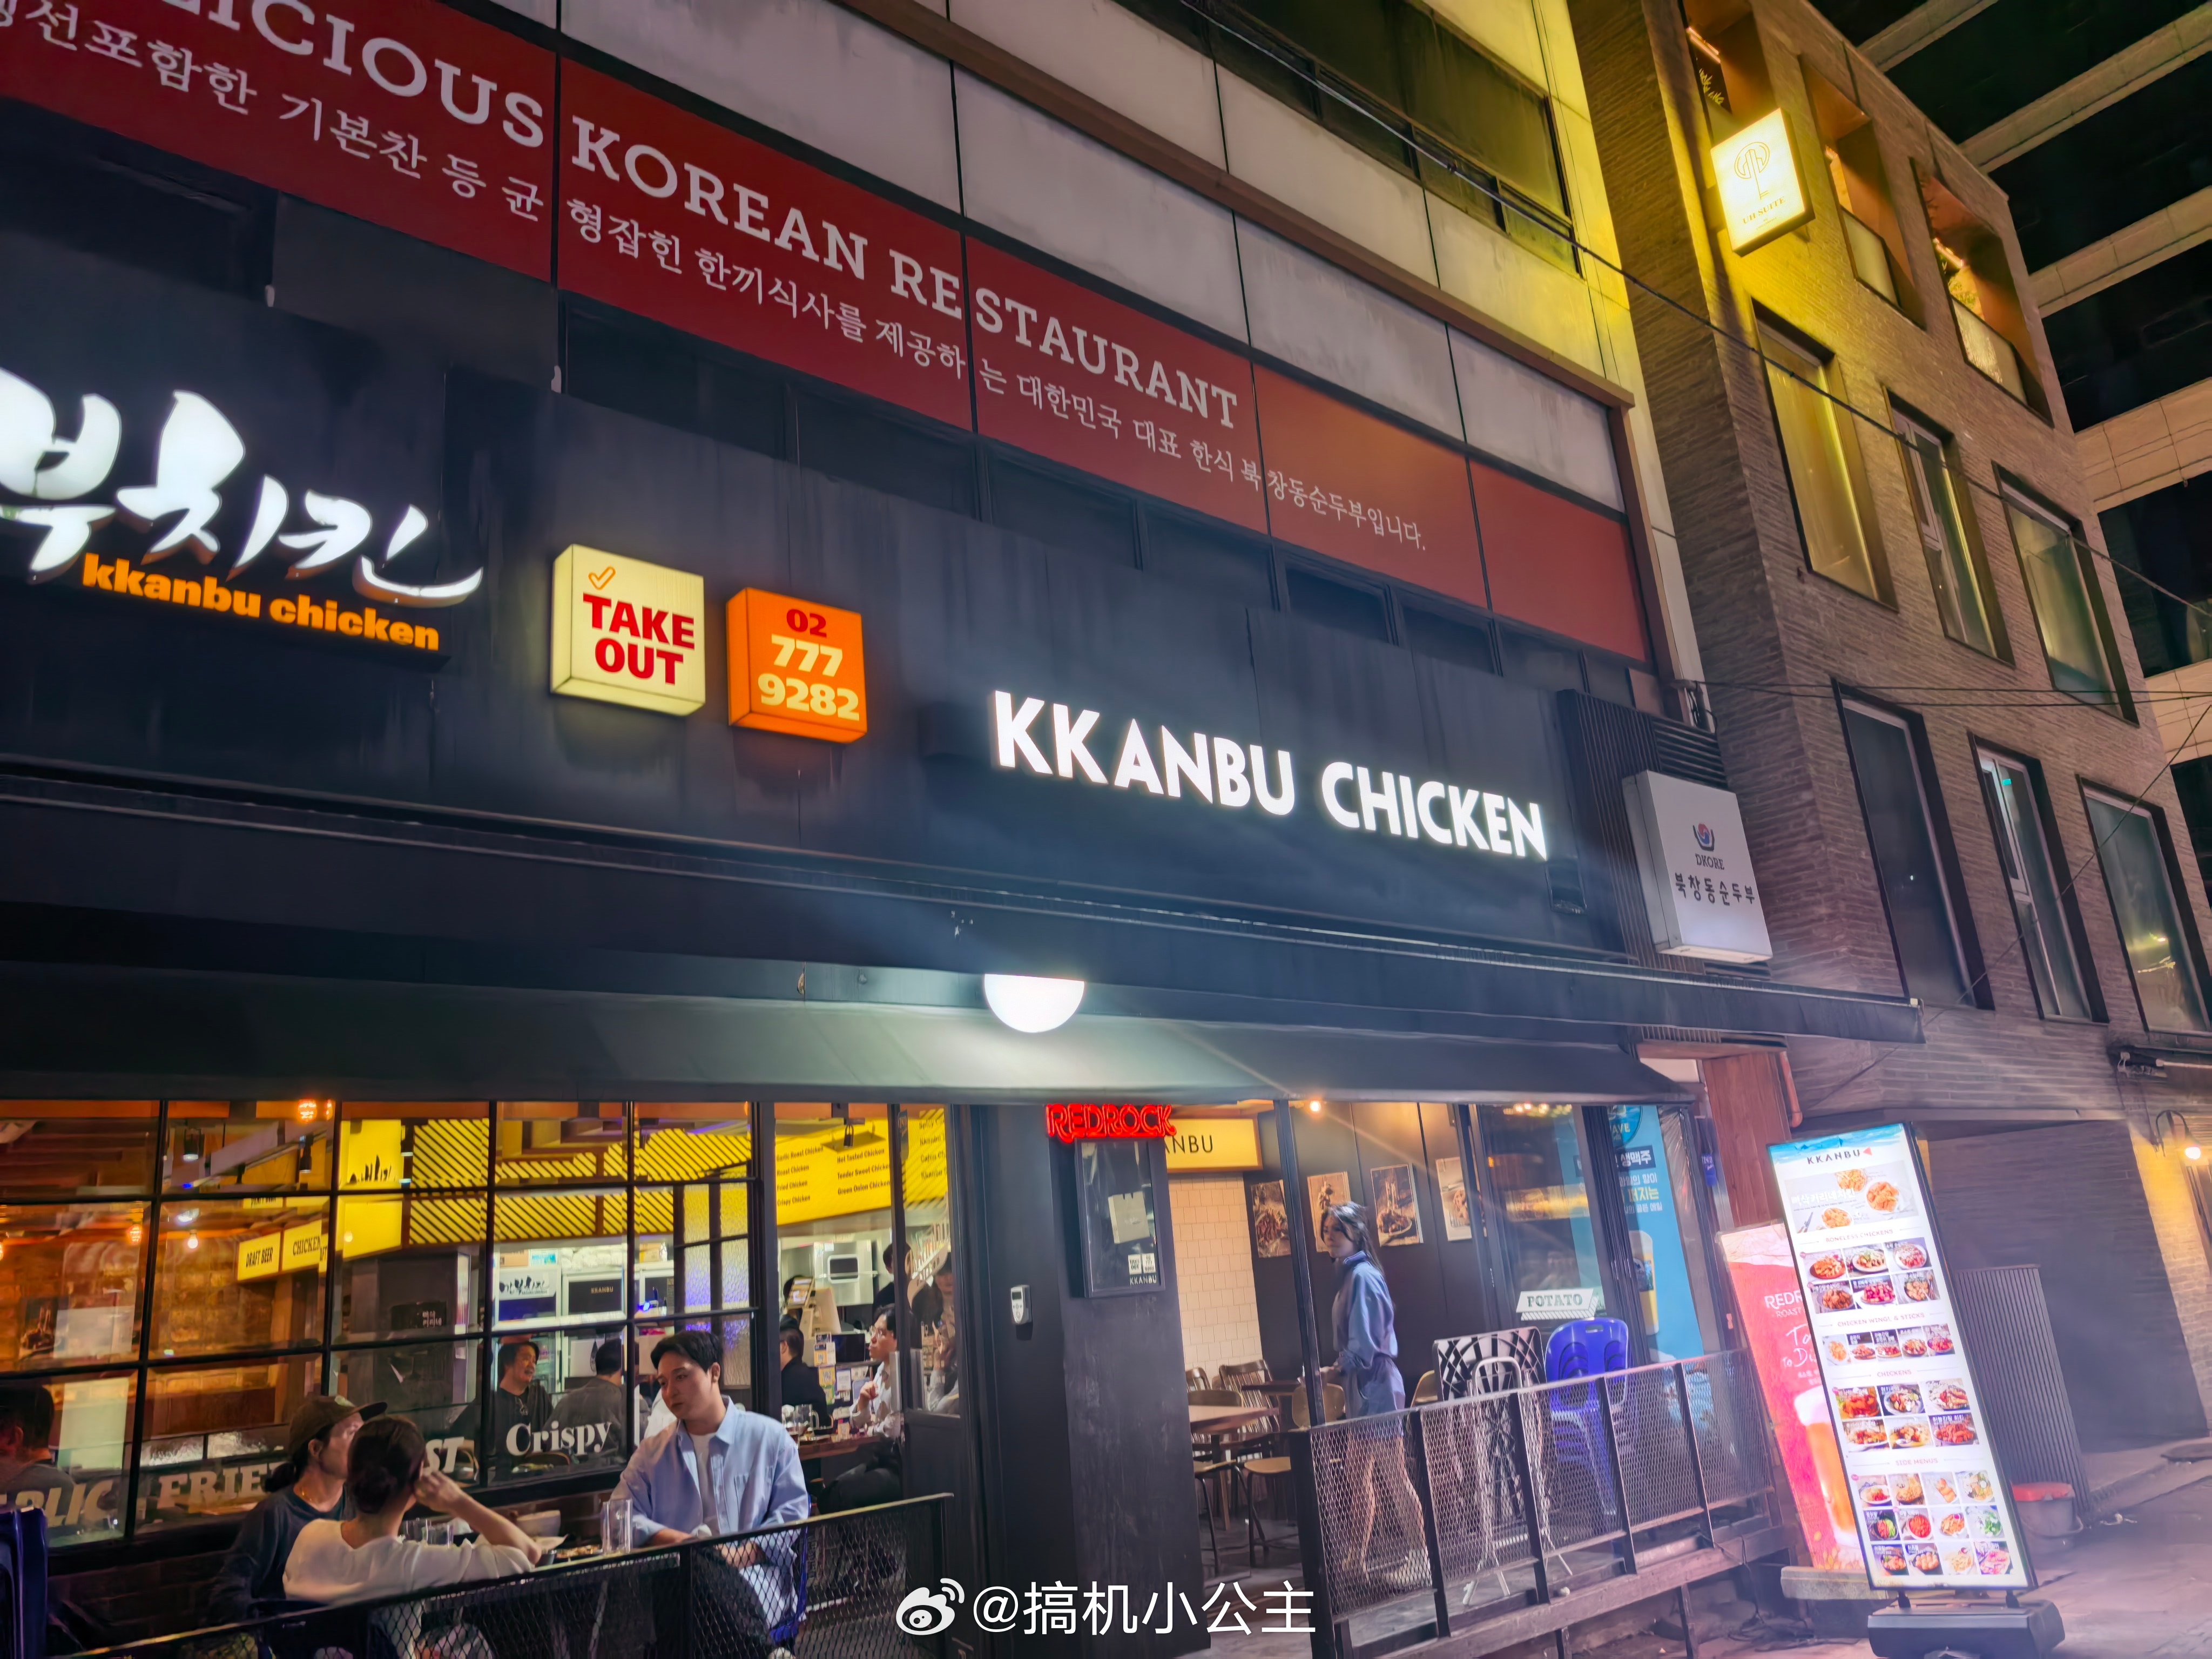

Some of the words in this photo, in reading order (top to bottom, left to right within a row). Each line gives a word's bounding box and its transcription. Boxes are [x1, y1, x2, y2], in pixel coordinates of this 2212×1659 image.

[572, 115, 867, 280] KOREAN
[279, 94, 428, 179] 기본찬
[442, 154, 487, 198] 등
[695, 248, 866, 343] 한끼식사를
[1017, 374, 1121, 439] 대한민국
[1133, 419, 1181, 459] 대표
[1190, 439, 1233, 482] 한식
[83, 553, 260, 618] kkanbu
[269, 594, 440, 650] chicken
[583, 592, 695, 650] TAKE
[786, 609, 827, 638] 02
[595, 638, 684, 685] OUT
[771, 634, 842, 677] 777
[758, 673, 860, 721] 9282
[994, 690, 1295, 816] KKANBU
[1321, 761, 1548, 861] CHICKEN
[1046, 1103, 1177, 1144] REDROCK
[1610, 1123, 1630, 1135] AVE
[864, 1148, 885, 1158] Chicken
[1165, 1135, 1213, 1155] NBU
[1807, 1149, 1860, 1164] KKANBU
[246, 1250, 261, 1267] DRAFT
[261, 1247, 273, 1263] BEER
[293, 1236, 321, 1256] CHICKEN
[1826, 1234, 1859, 1243] BONELESS
[1130, 1276, 1157, 1285] KKANBU
[1527, 1293, 1583, 1307] POTATO
[1877, 1370, 1912, 1378] CHICKENS
[426, 1437, 464, 1473] ST
[506, 1420, 612, 1456] Crispy
